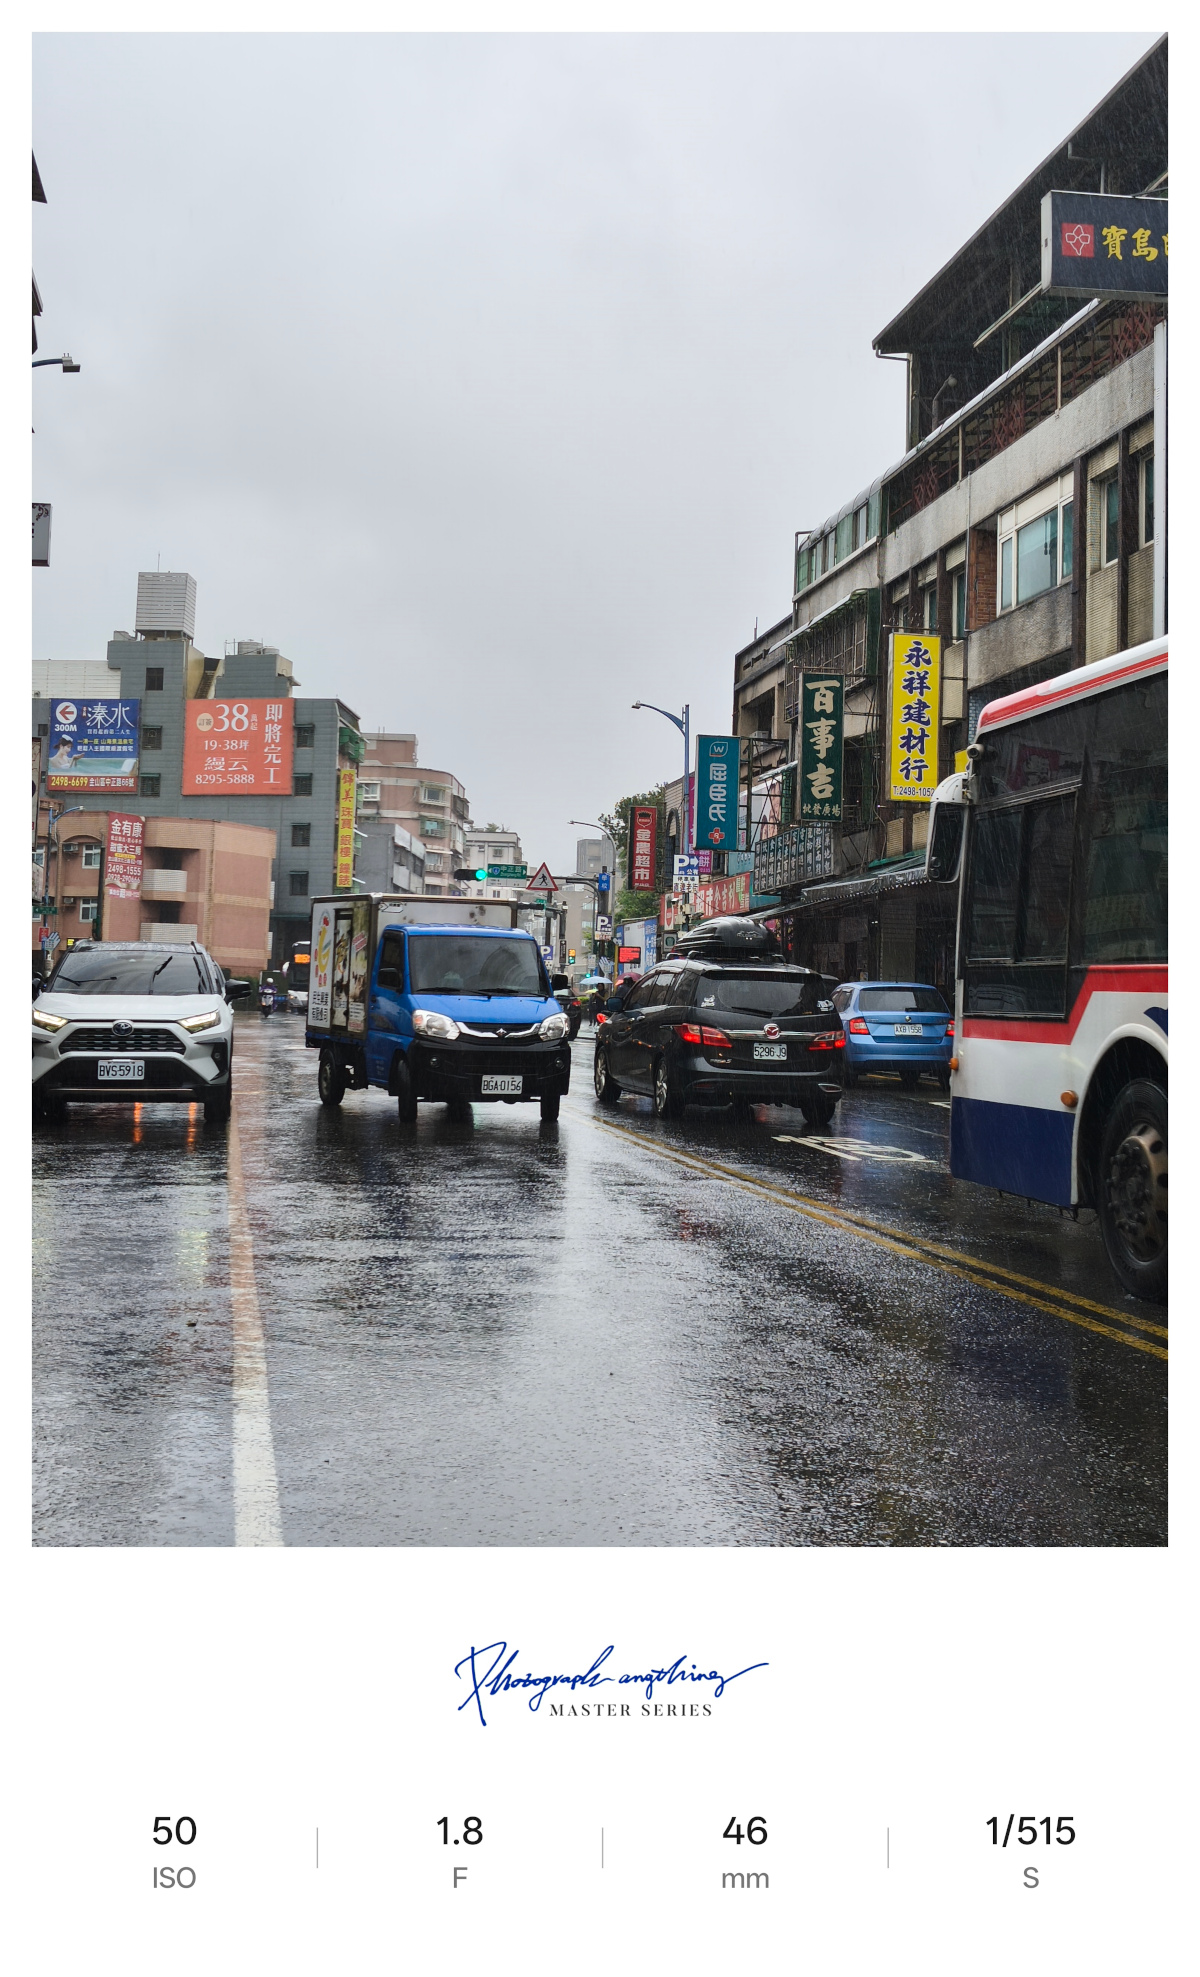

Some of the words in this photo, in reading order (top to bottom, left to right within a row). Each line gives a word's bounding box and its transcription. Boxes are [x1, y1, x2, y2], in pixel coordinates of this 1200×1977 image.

[1101, 225, 1168, 262] 寶島
[213, 703, 249, 732] 38
[899, 640, 933, 783] 永祥建材行
[54, 723, 78, 732] 300M
[263, 704, 283, 784] 即將完工
[805, 679, 840, 799] 百事吉
[51, 776, 89, 787] 2498-6699
[195, 773, 255, 784] 8295-5888
[709, 763, 727, 822] 屈臣氏
[802, 802, 841, 817] 批發廣場
[110, 818, 143, 838] 金有康
[107, 863, 142, 876] 2498-1555
[674, 854, 690, 874] P
[597, 915, 608, 931] P
[99, 1065, 144, 1077] BVS-5918
[482, 1079, 522, 1091] BGA-0156
